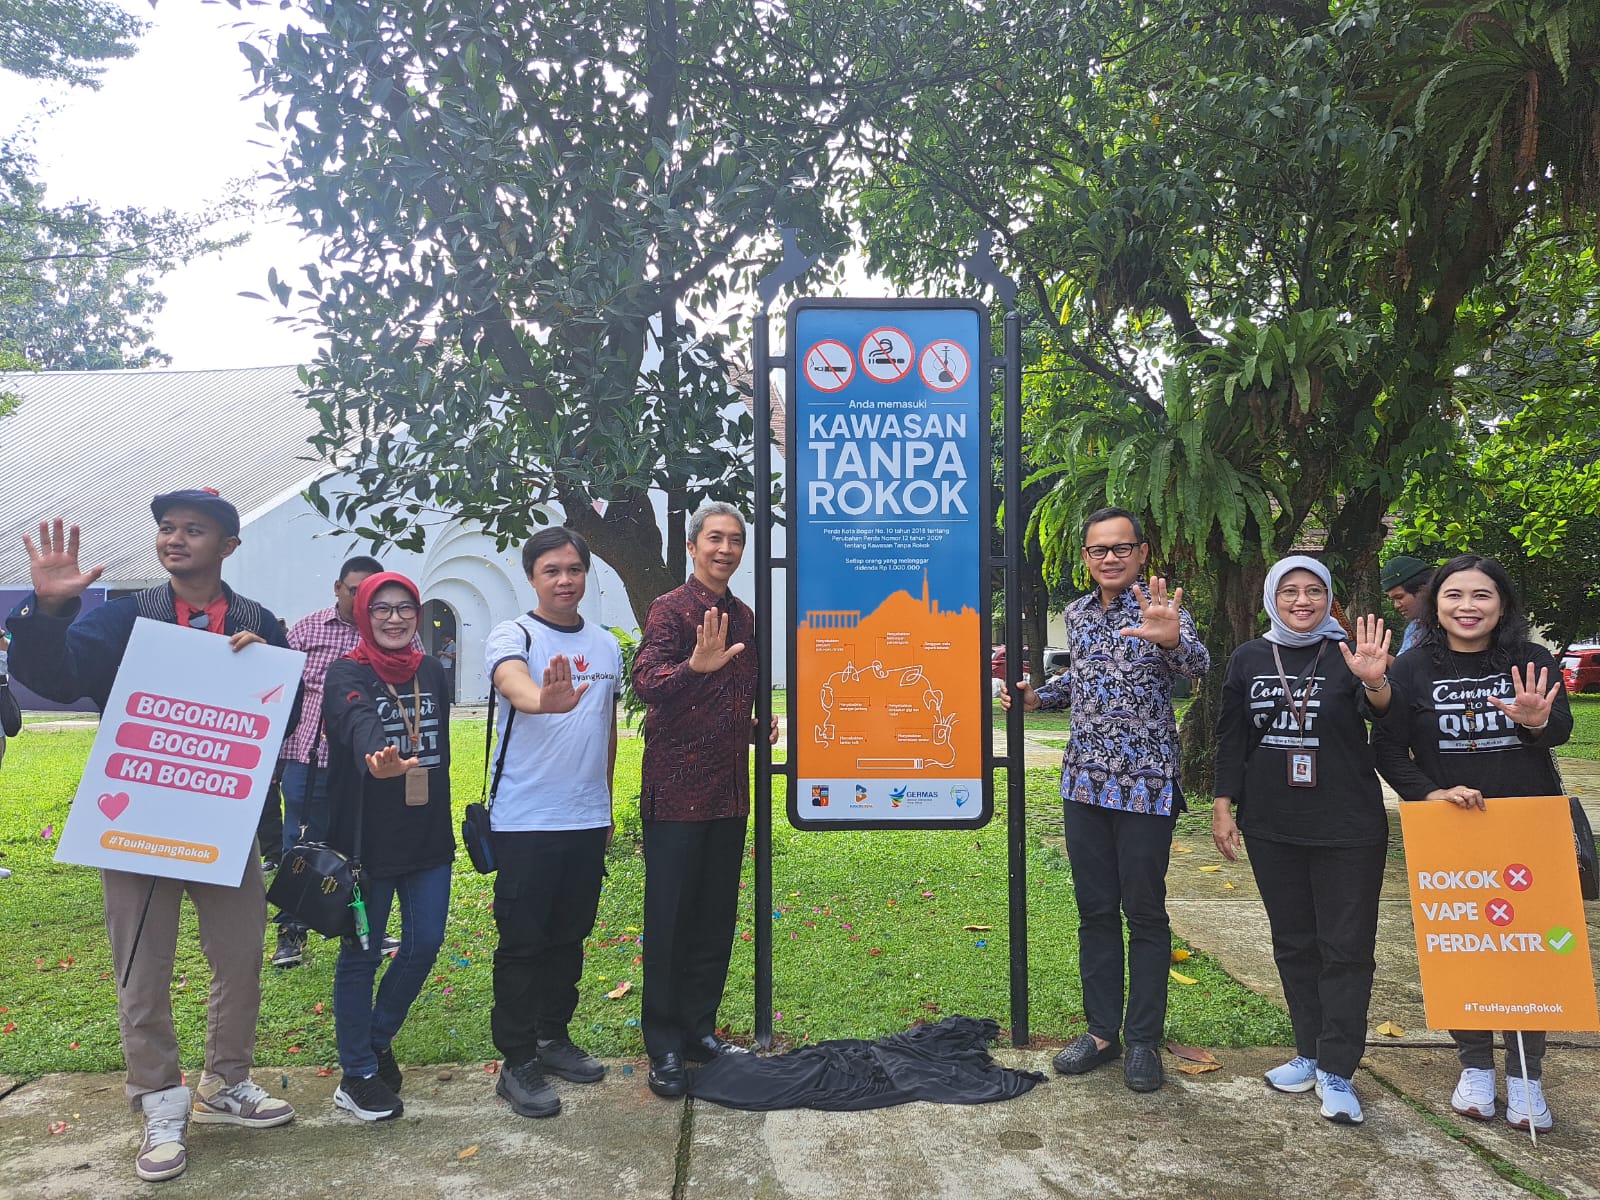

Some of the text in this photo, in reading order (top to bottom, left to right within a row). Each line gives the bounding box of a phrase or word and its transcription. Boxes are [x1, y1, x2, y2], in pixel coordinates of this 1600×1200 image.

[848, 399, 927, 409] Anda memasuki
[809, 413, 966, 438] KAWASAN
[808, 441, 967, 479] TANPA
[808, 479, 968, 515] ROKOK
[856, 528, 874, 536] Bogor
[927, 527, 950, 535] tentang
[844, 542, 867, 550] tentang
[898, 557, 929, 565] melanggar
[1432, 678, 1512, 702] Commit
[137, 696, 259, 739] BOGORIAN,
[149, 731, 230, 762] BOGOH
[120, 758, 239, 795] KA BOGOR
[1418, 870, 1500, 889] ROKOK
[1421, 902, 1479, 920] VAPE
[1426, 933, 1545, 952] PERDA KTR
[1464, 1003, 1563, 1015] #TeuHayangRokok
